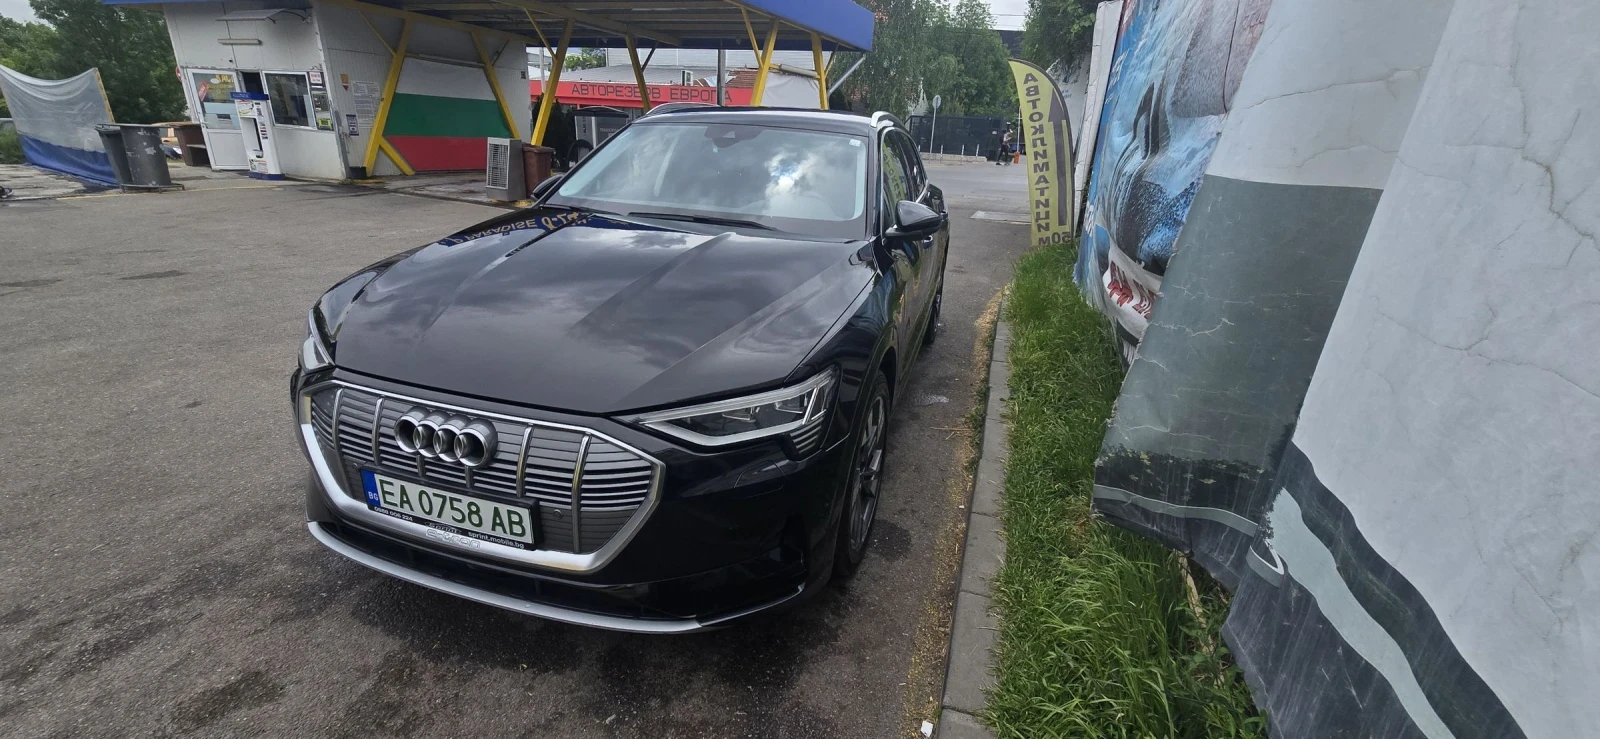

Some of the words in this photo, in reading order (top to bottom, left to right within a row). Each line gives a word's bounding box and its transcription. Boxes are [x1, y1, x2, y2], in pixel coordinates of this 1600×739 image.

[368, 491, 379, 501] BG
[379, 479, 415, 512] EA
[418, 490, 483, 528] 0758
[491, 506, 526, 538] AB
[426, 528, 481, 548] e-tron
[468, 531, 525, 549] sprint.mobile.bg
